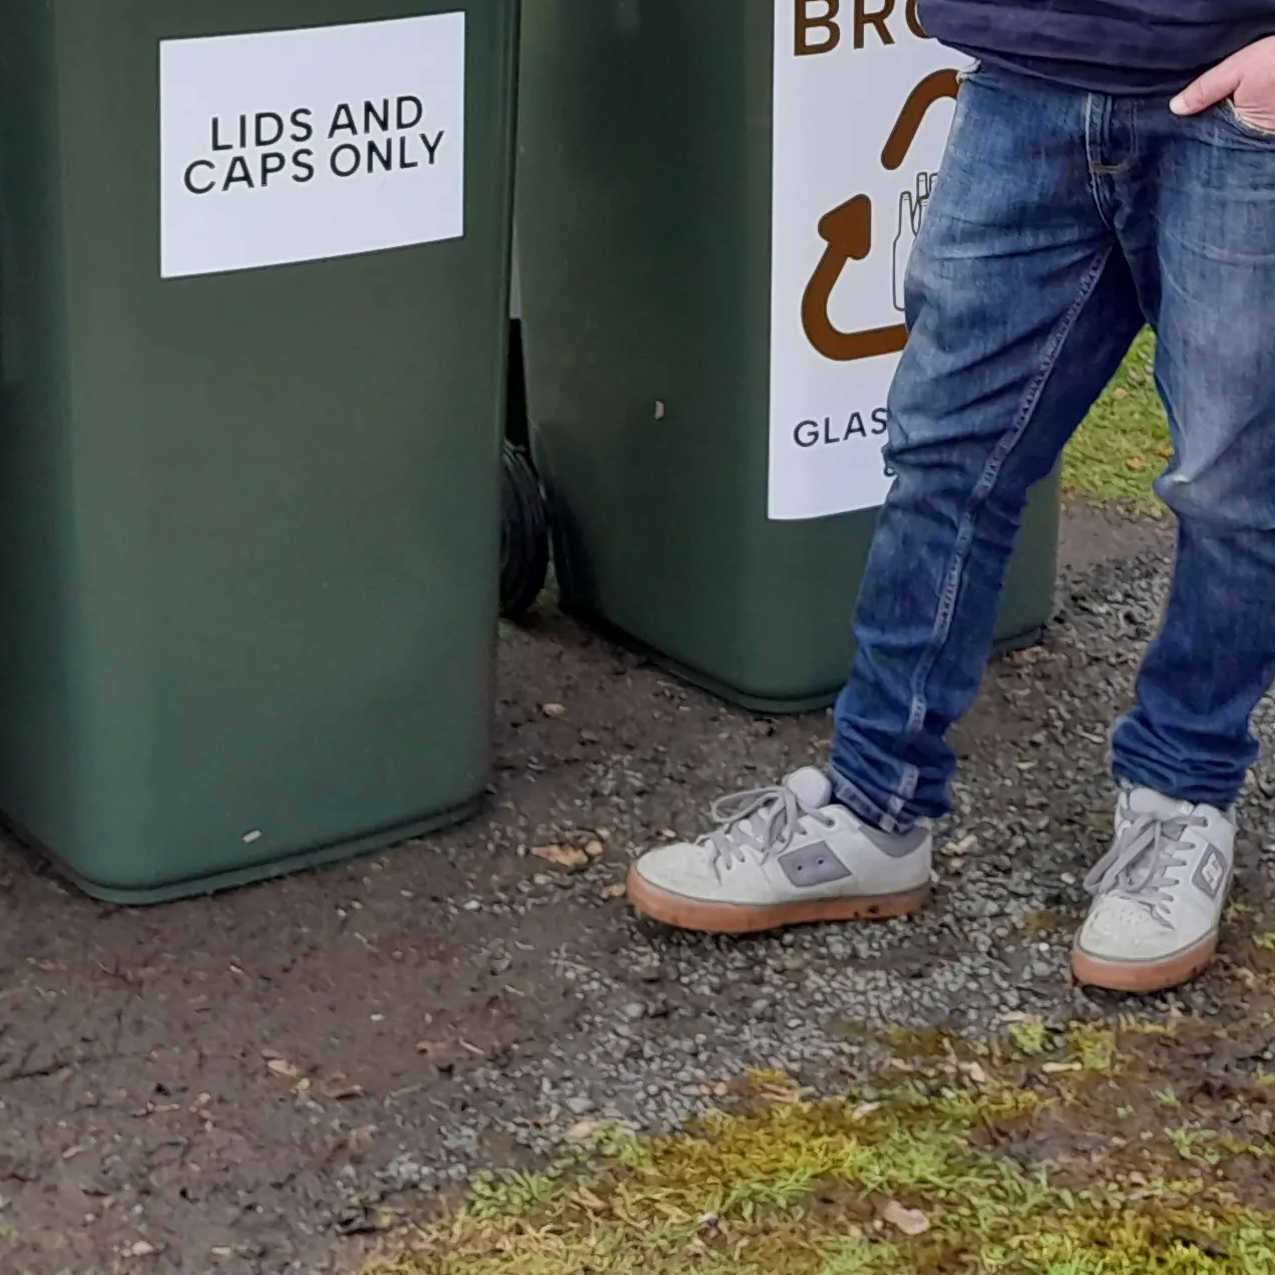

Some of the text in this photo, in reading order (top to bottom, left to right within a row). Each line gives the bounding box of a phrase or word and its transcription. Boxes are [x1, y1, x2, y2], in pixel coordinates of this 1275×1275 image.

[210, 95, 423, 152] LIDS AND
[183, 129, 445, 195] CAPS ONLY
